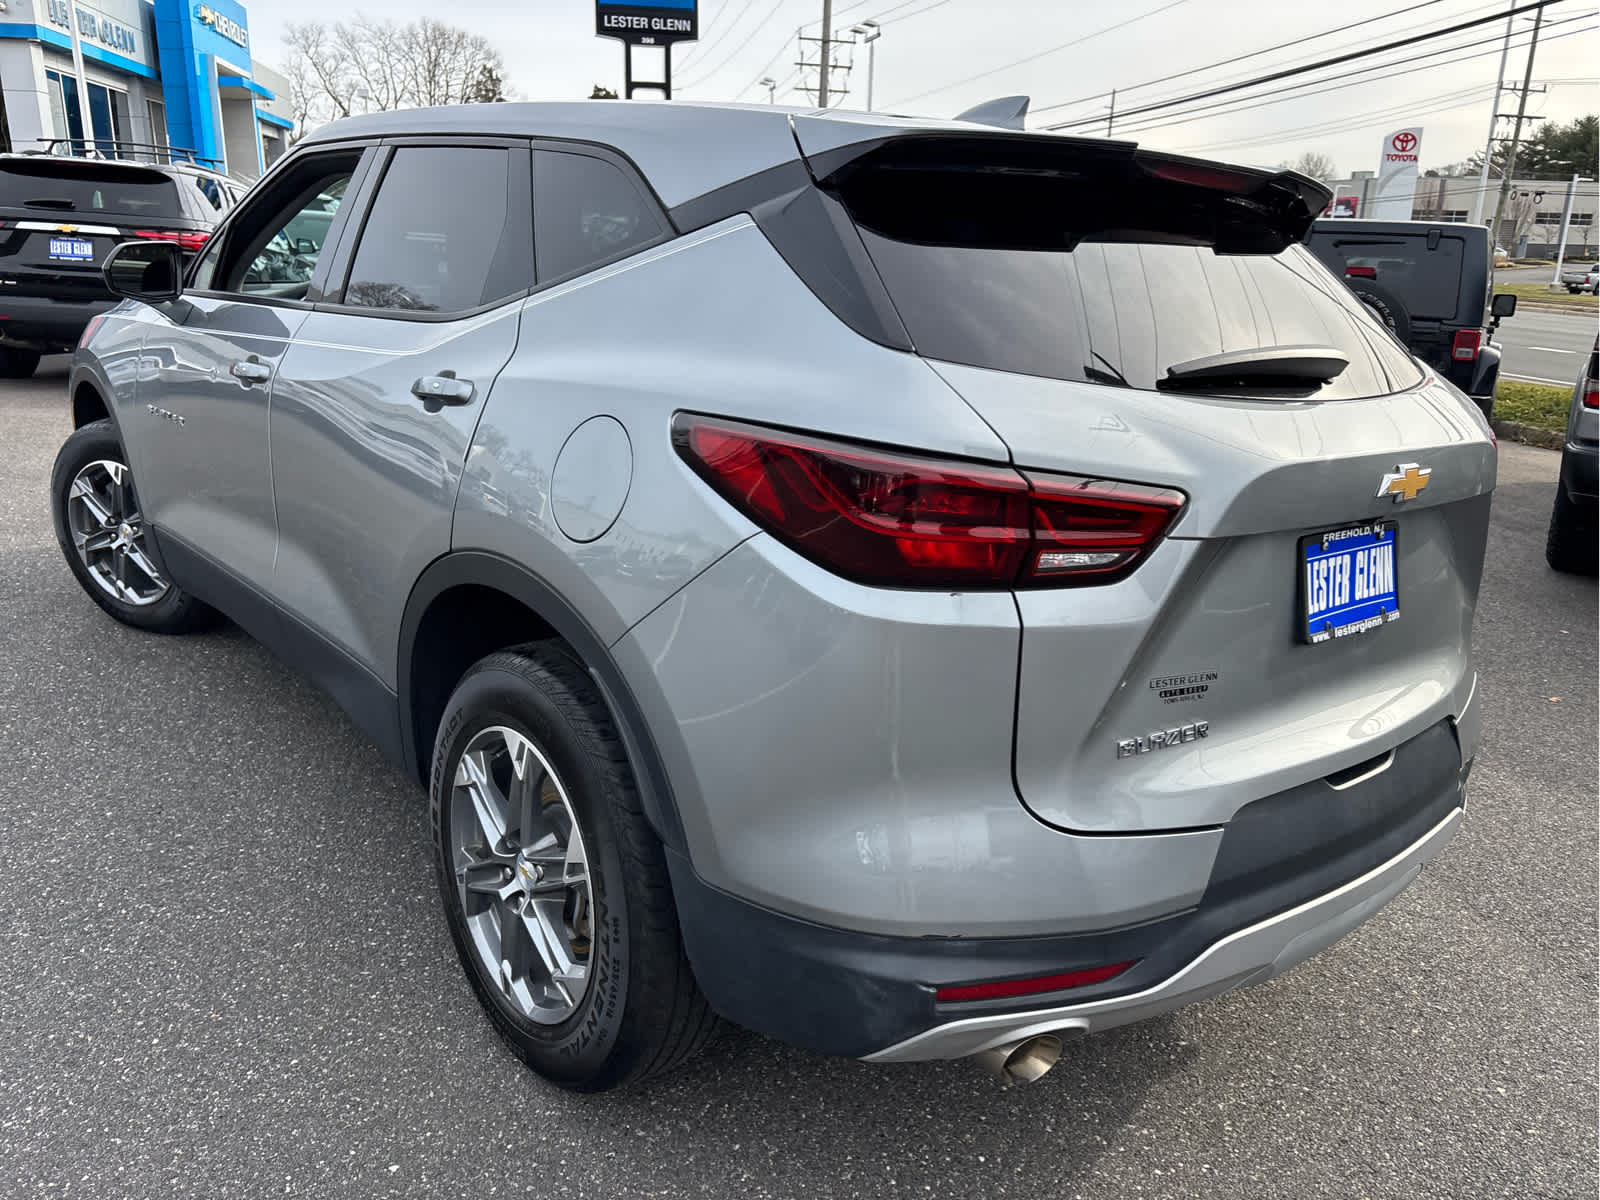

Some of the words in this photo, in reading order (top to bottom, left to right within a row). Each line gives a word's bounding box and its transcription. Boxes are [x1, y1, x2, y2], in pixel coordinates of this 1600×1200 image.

[48, 0, 97, 38] LETER
[603, 15, 649, 29] LESTER
[651, 17, 692, 31] GLENN
[1386, 153, 1418, 162] TOYOTA
[1306, 554, 1351, 615] LESTER
[1355, 544, 1394, 601] GLENN
[1149, 677, 1186, 689] LESTER
[1187, 672, 1218, 684] GLENN
[1117, 720, 1209, 760] BLAZER
[560, 870, 611, 1057] NTINENTAL
